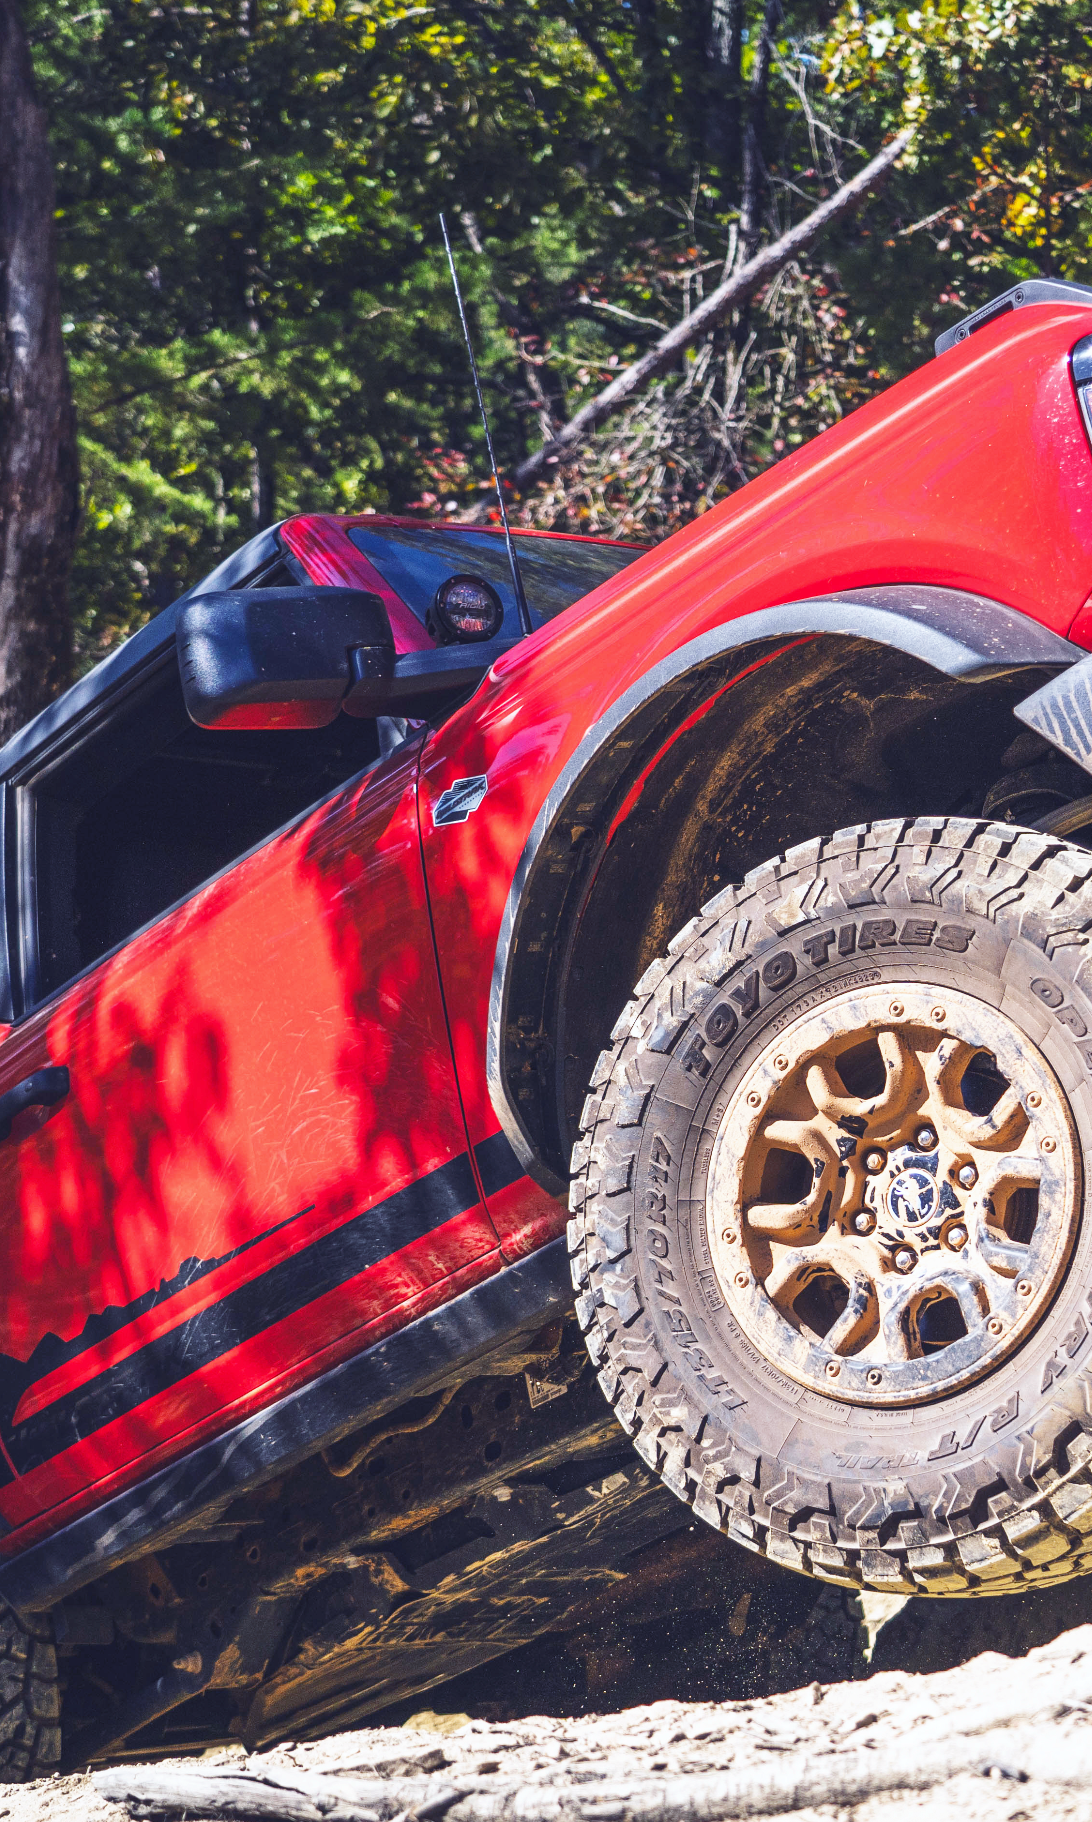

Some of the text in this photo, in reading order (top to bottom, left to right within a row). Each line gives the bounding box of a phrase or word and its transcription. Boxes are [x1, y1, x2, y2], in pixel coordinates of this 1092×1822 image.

[460, 602, 486, 610] RIGID
[680, 917, 975, 1077] TOYO TIRES
[928, 1391, 1019, 1461] R/T
[836, 1451, 919, 1470] TRAIL
